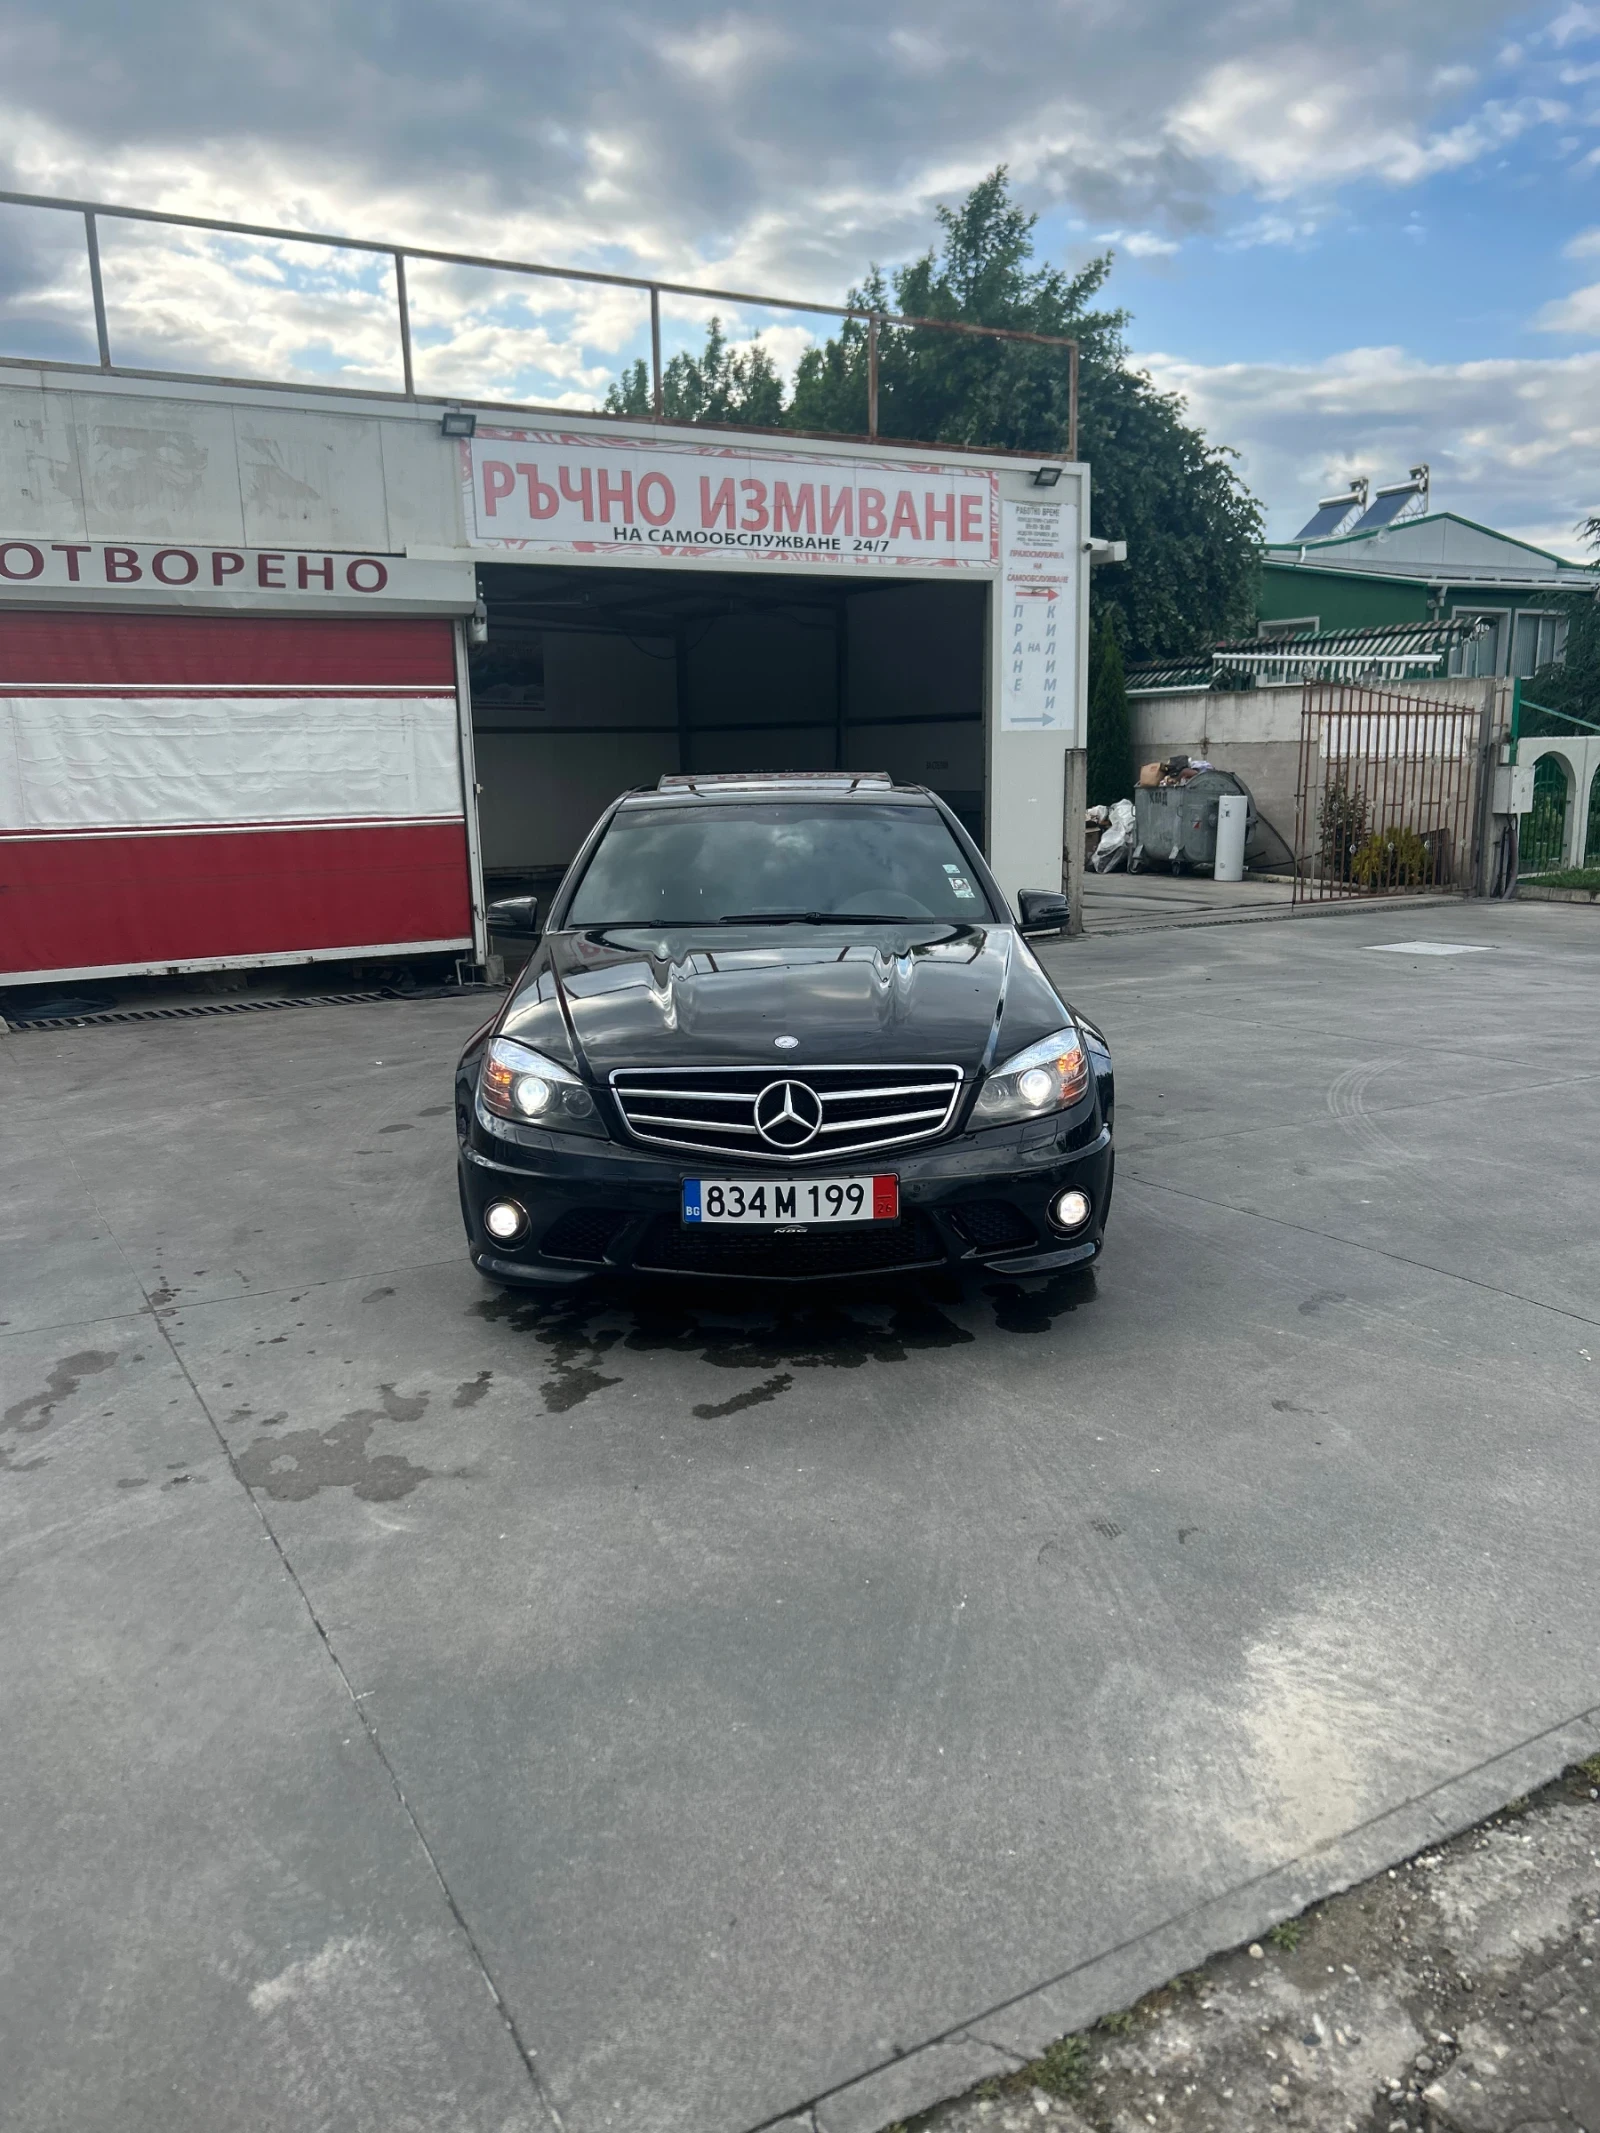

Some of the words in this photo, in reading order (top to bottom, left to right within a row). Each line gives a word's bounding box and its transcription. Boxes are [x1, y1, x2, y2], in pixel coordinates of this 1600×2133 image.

[482, 460, 676, 527] РЪЧНО
[699, 475, 984, 542] ИЗМИВАНЕ
[613, 527, 642, 542] НА
[648, 528, 841, 552] САМООБСЛУЖВАНЕ
[852, 539, 890, 553] 24/7
[0, 542, 389, 594] ОТВОРЕНО
[1028, 643, 1041, 653] НА
[686, 1206, 700, 1216] BG
[706, 1185, 767, 1218] 834
[775, 1185, 796, 1218] M
[808, 1183, 865, 1217] 199
[877, 1202, 892, 1214] 26
